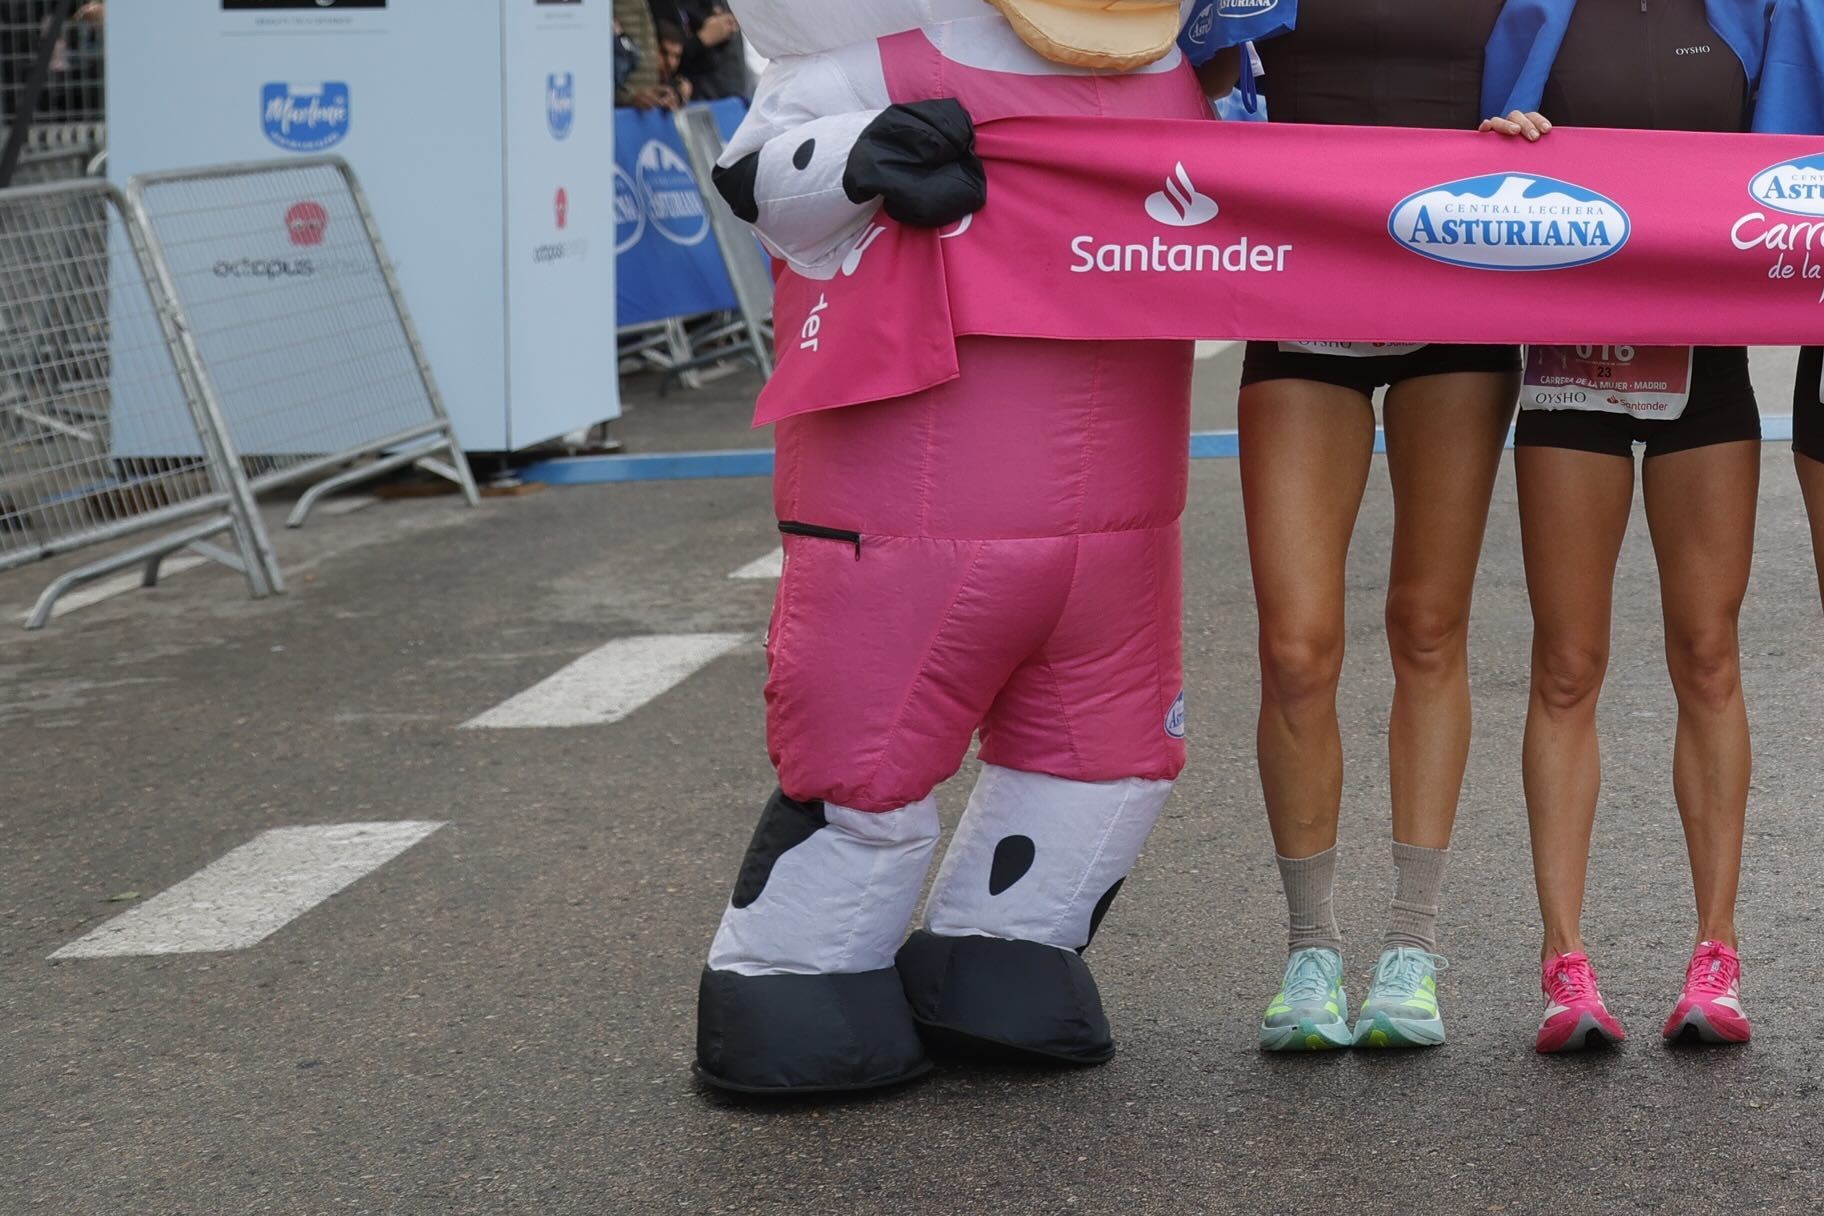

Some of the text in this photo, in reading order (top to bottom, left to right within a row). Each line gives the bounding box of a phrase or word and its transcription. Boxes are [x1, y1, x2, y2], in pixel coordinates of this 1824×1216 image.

[1675, 45, 1711, 56] OYSHO
[1444, 202, 1606, 216] CENTRAL LECHERA
[1407, 204, 1612, 248] ASTURIANA
[1070, 234, 1293, 274] Santander
[1768, 252, 1796, 280] de
[1802, 251, 1822, 280] la
[1597, 367, 1612, 378] 23
[1540, 376, 1668, 391] CARRERA DE LA MUJER MADRID
[1535, 391, 1587, 404] OYSHO
[1619, 399, 1668, 411] Santander
